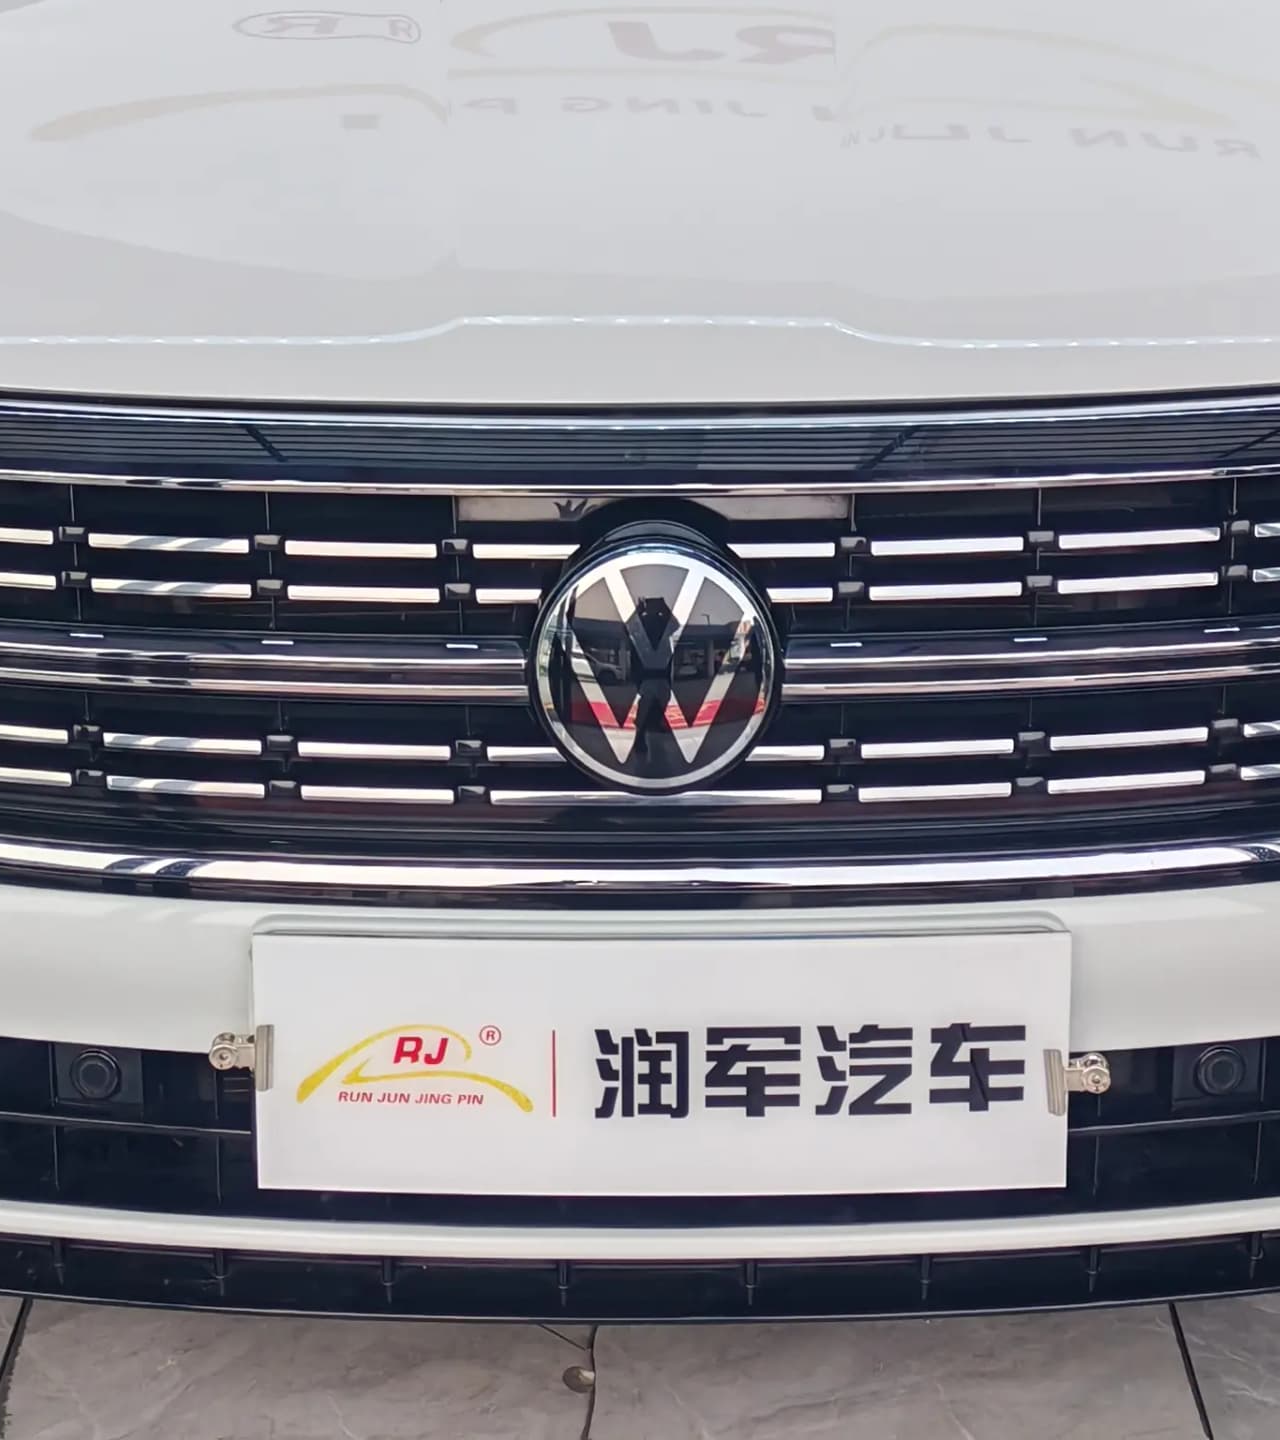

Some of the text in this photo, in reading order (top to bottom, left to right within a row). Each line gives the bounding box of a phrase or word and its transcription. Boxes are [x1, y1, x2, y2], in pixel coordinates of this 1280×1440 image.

[392, 1036, 449, 1065] RJ
[593, 1022, 1027, 1119] 润军汽车
[337, 1090, 485, 1106] RUN JUN JING PIN
